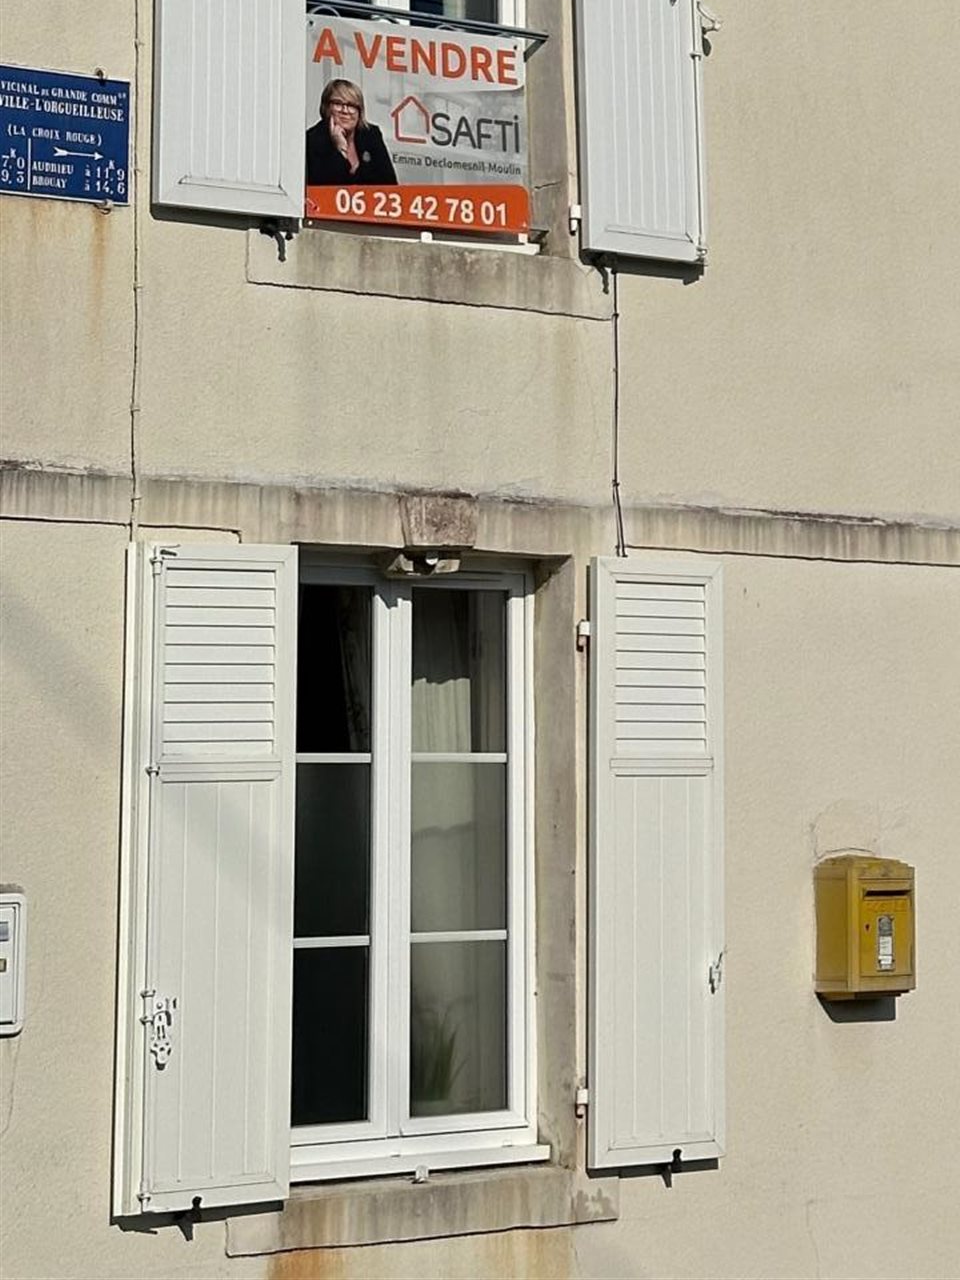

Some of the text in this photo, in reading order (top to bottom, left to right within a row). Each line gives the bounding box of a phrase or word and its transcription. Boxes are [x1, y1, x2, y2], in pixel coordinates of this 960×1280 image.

[312, 28, 519, 86] A VENDRE
[0, 80, 40, 95] VICINAL
[51, 87, 88, 101] GRANDE
[7, 123, 102, 147] (LA CROIX ROUGE)
[32, 161, 74, 175] AUDRIEU
[392, 153, 422, 166] Emma
[32, 174, 68, 189] BROUAY
[336, 189, 507, 226] 06 23 42 78 01
